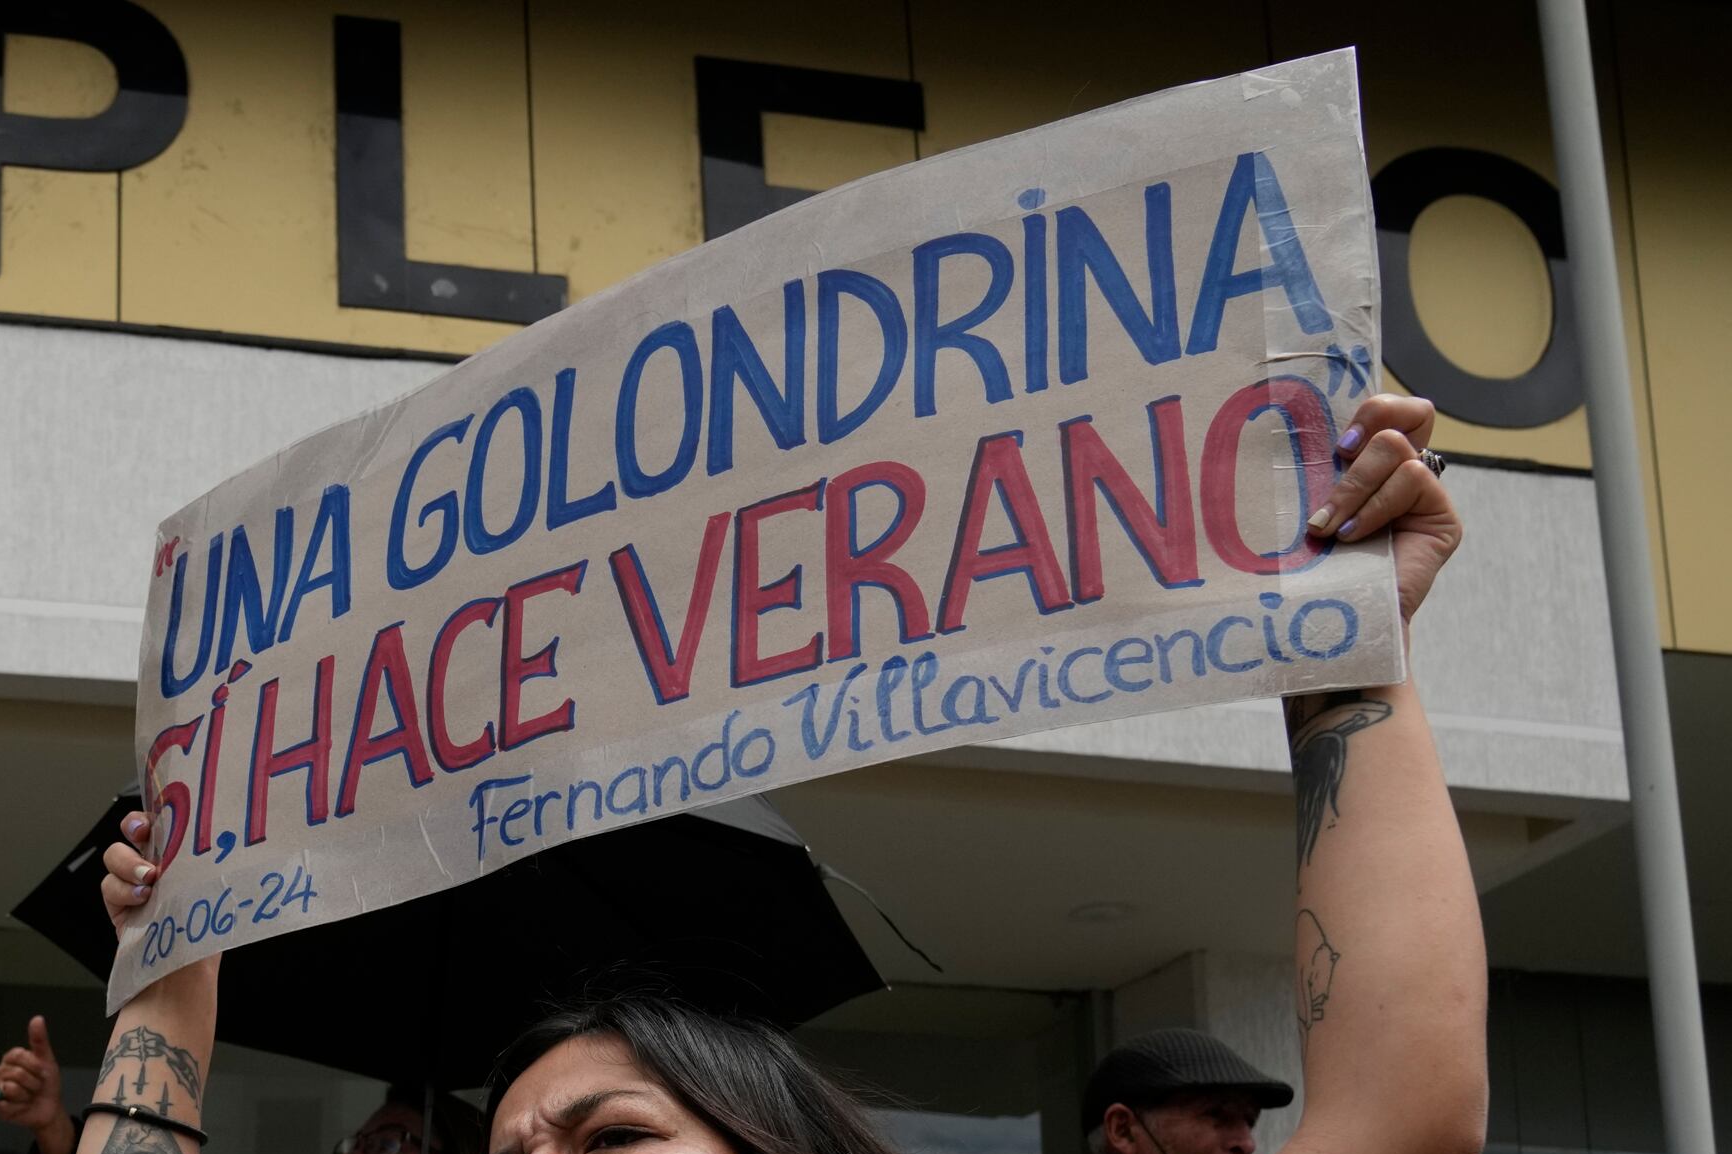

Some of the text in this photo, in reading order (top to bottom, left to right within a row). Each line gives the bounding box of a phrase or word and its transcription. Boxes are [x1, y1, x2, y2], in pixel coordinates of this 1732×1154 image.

[387, 152, 1335, 591] GOLONDRINA
[244, 558, 588, 848] HACE
[470, 591, 1360, 861] Fernando Villavicencio
[141, 865, 318, 968] 20-06-24
